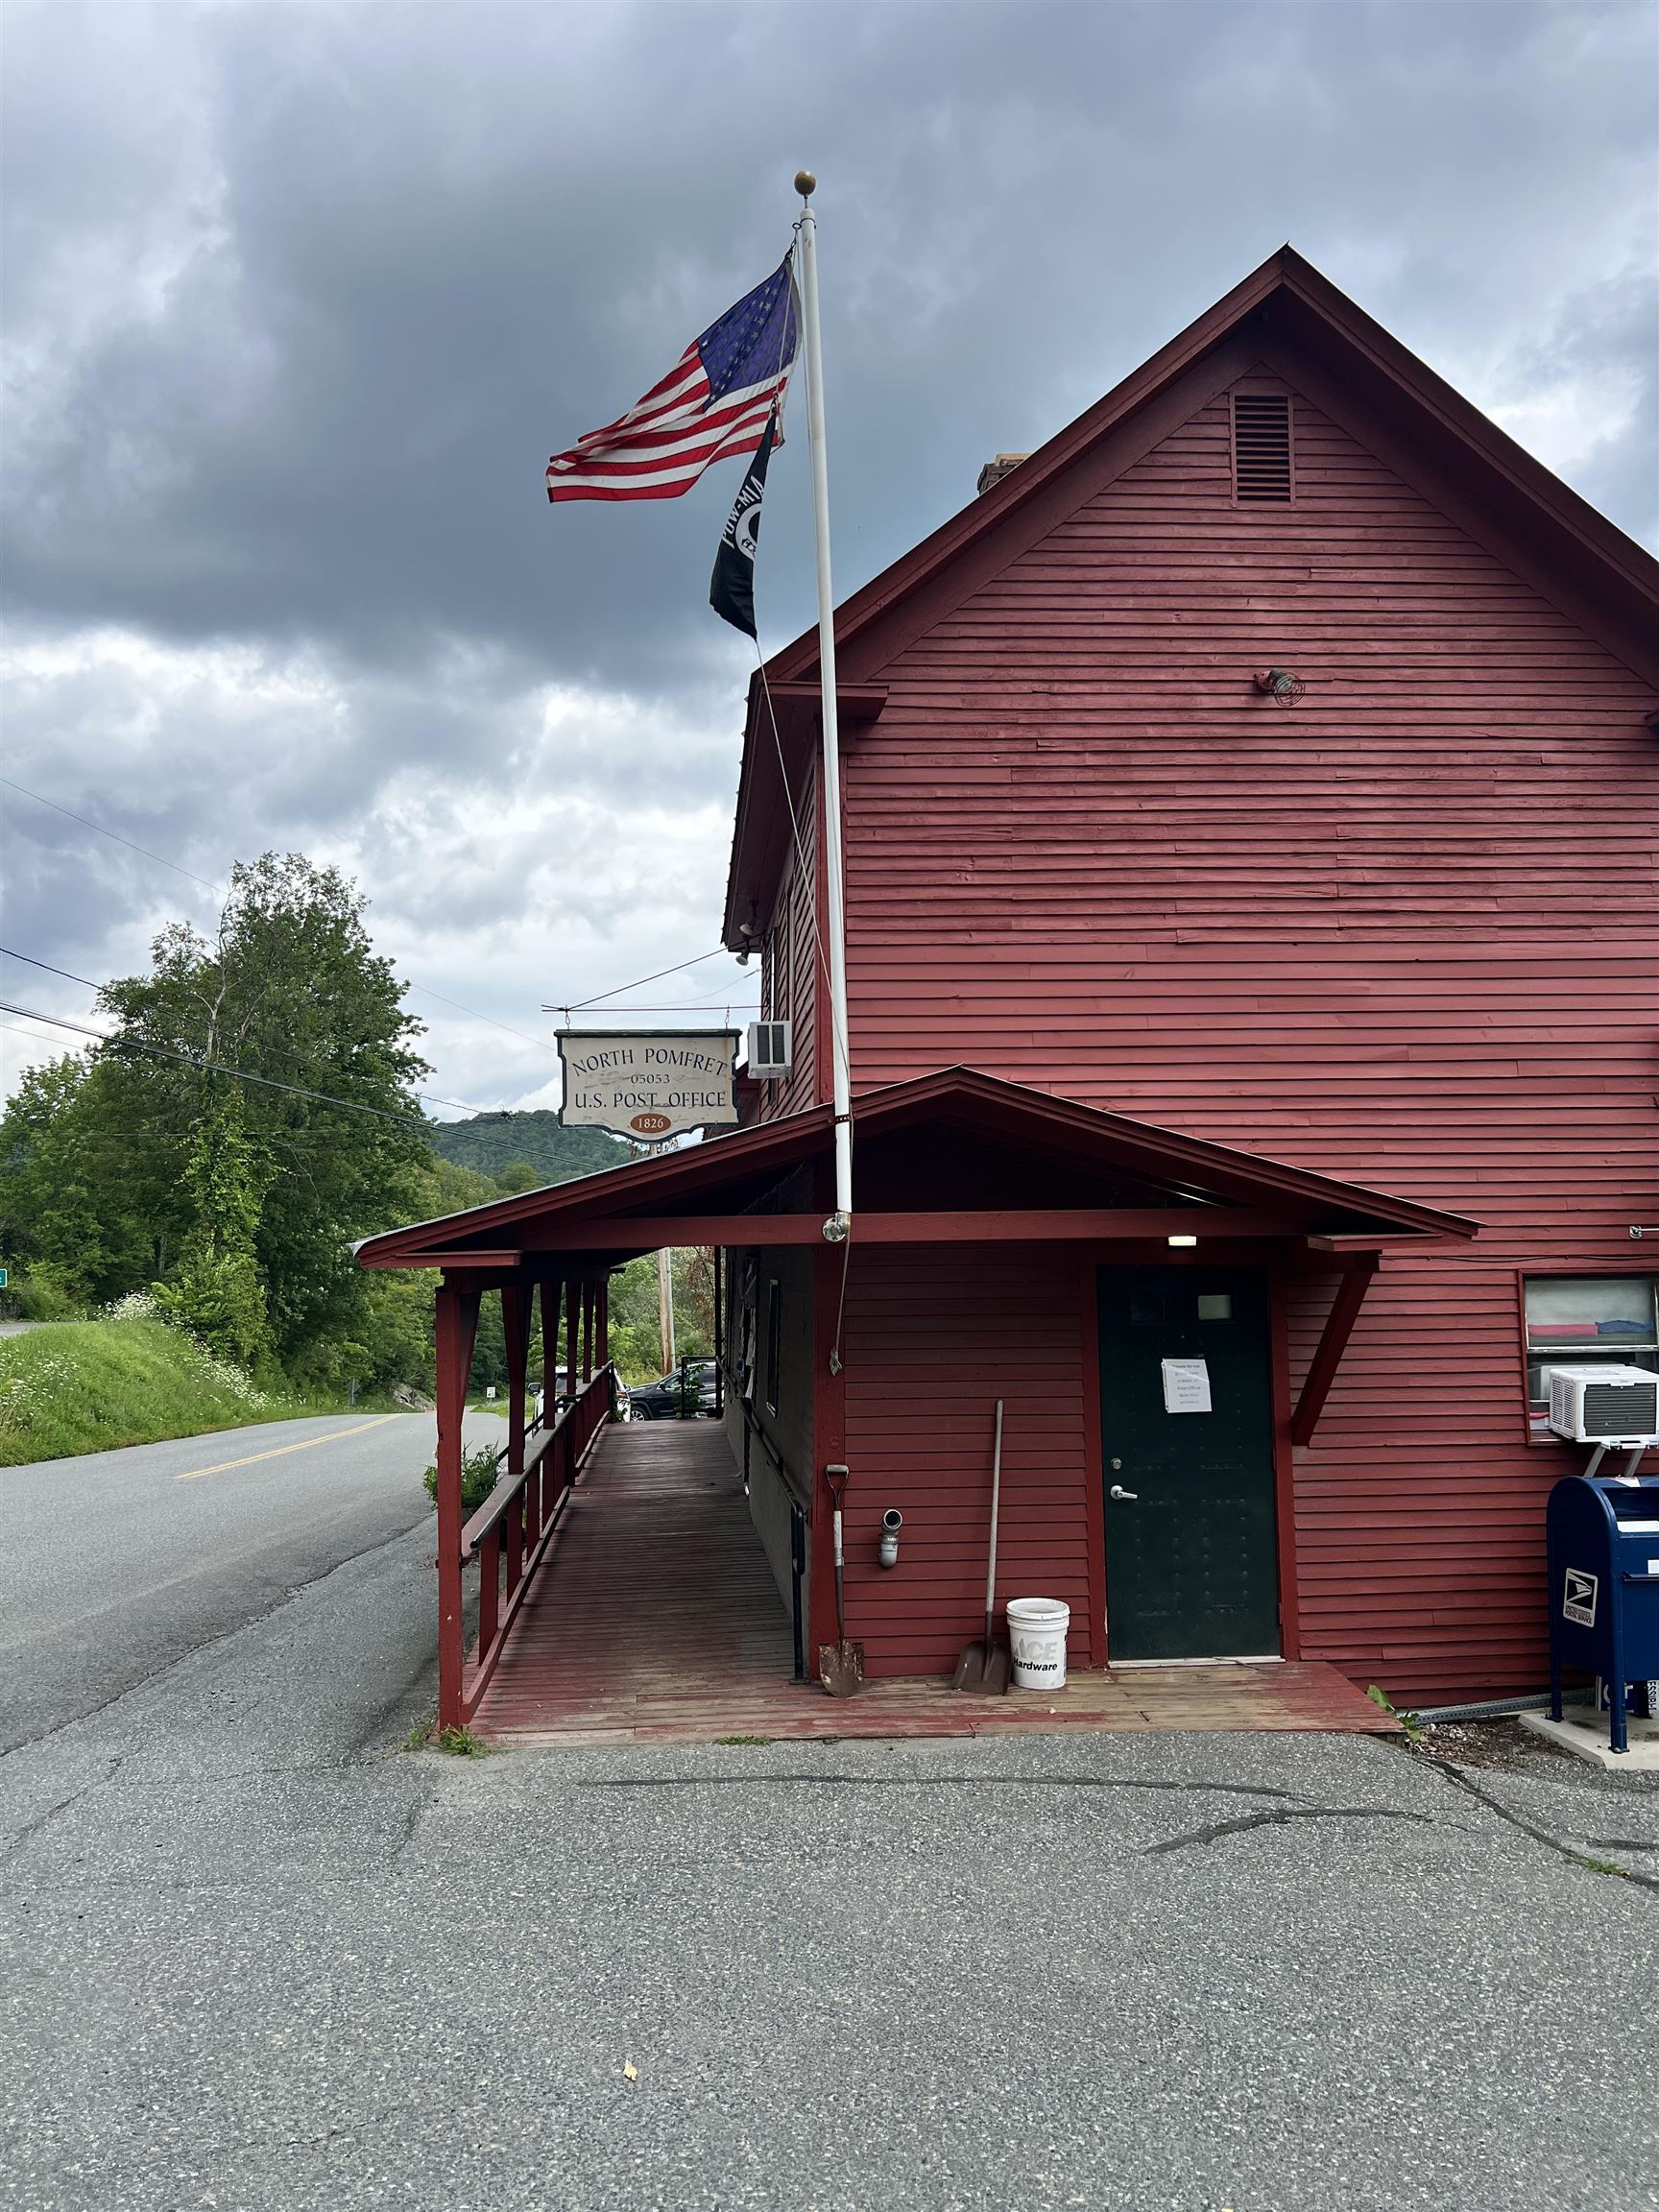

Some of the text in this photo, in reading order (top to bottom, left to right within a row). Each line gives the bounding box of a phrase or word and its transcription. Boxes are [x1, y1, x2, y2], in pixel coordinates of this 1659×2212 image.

[571, 1047, 728, 1076] NORTH POMFRET
[630, 1073, 670, 1084] 05053
[575, 1092, 726, 1108] U.S. POST OFFICE
[637, 1118, 663, 1129] 1826
[1014, 1637, 1058, 1661] ACE
[1013, 1657, 1058, 1671] Hardware
